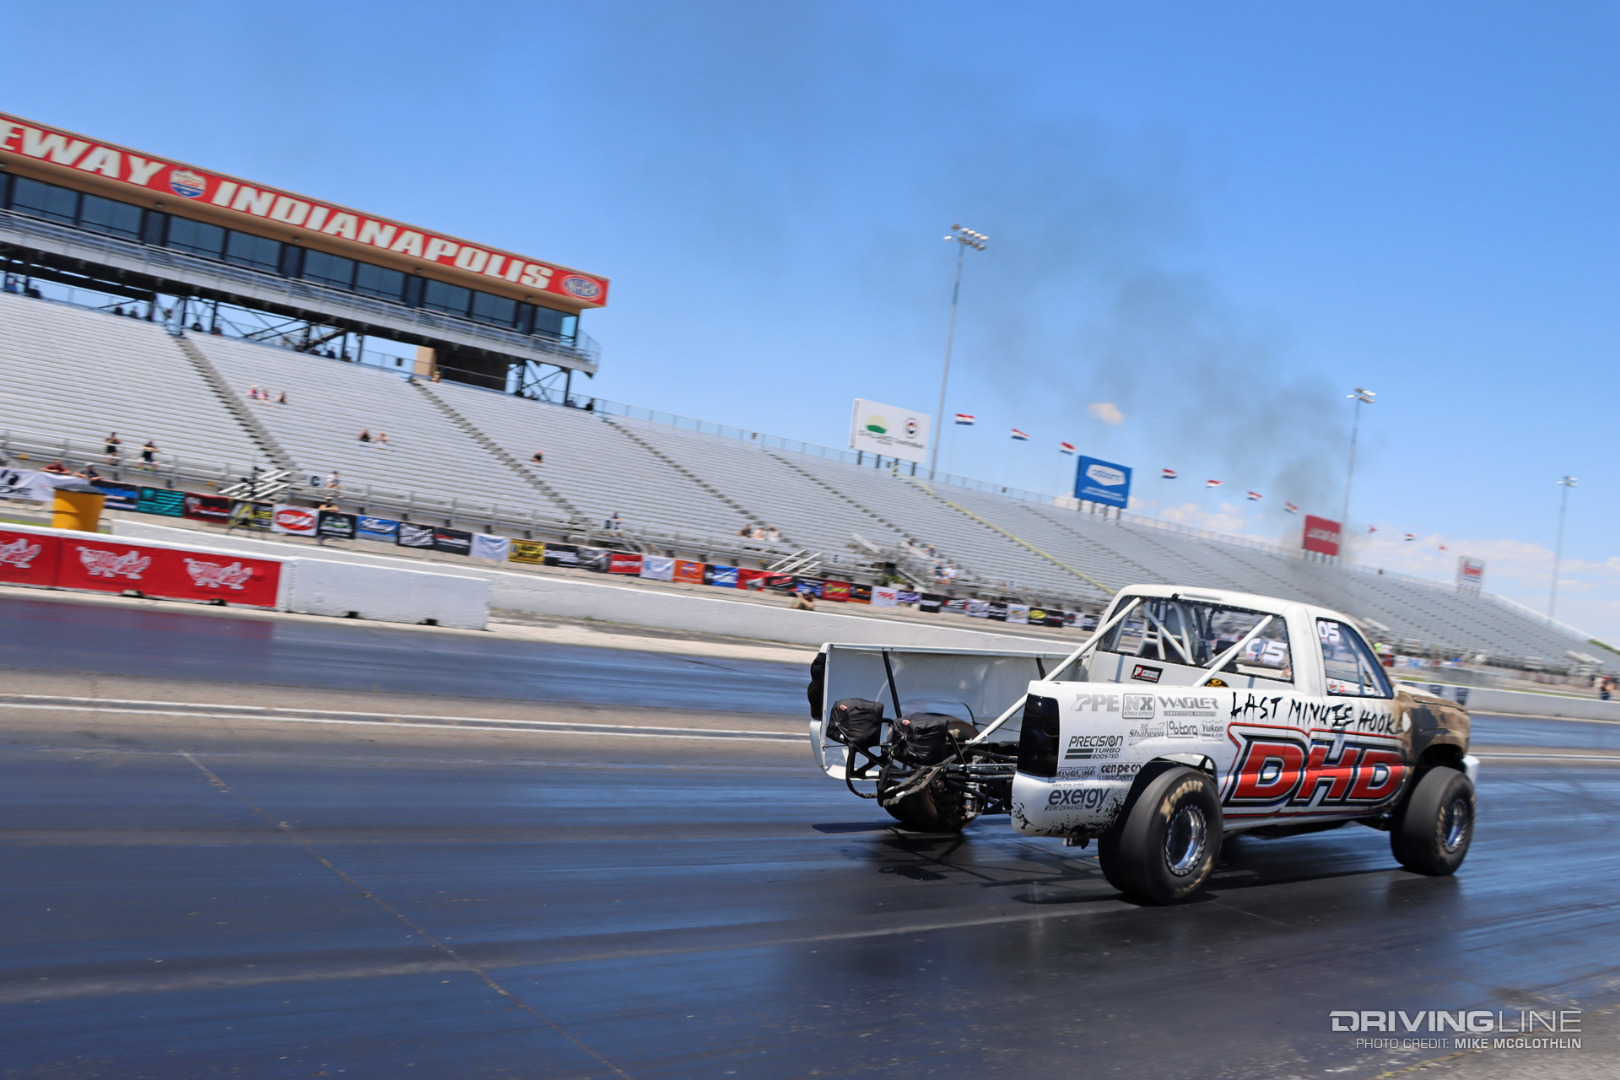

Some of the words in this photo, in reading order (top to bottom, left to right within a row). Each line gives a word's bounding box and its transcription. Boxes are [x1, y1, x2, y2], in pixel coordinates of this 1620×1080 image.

[211, 180, 553, 290] INDIANAPOLIS
[1317, 620, 1340, 643] 05
[1071, 693, 1120, 712] PPE
[1125, 696, 1153, 711] NX
[1157, 696, 1220, 710] WAGLER
[1230, 691, 1284, 719] LAST
[1288, 698, 1355, 728] MINUTE
[1357, 709, 1402, 735] HOOK
[1068, 735, 1124, 747] PRECISION
[1226, 740, 1408, 801] DHD
[1044, 804, 1085, 812] PERFORMANCE
[1048, 788, 1110, 810] exergy
